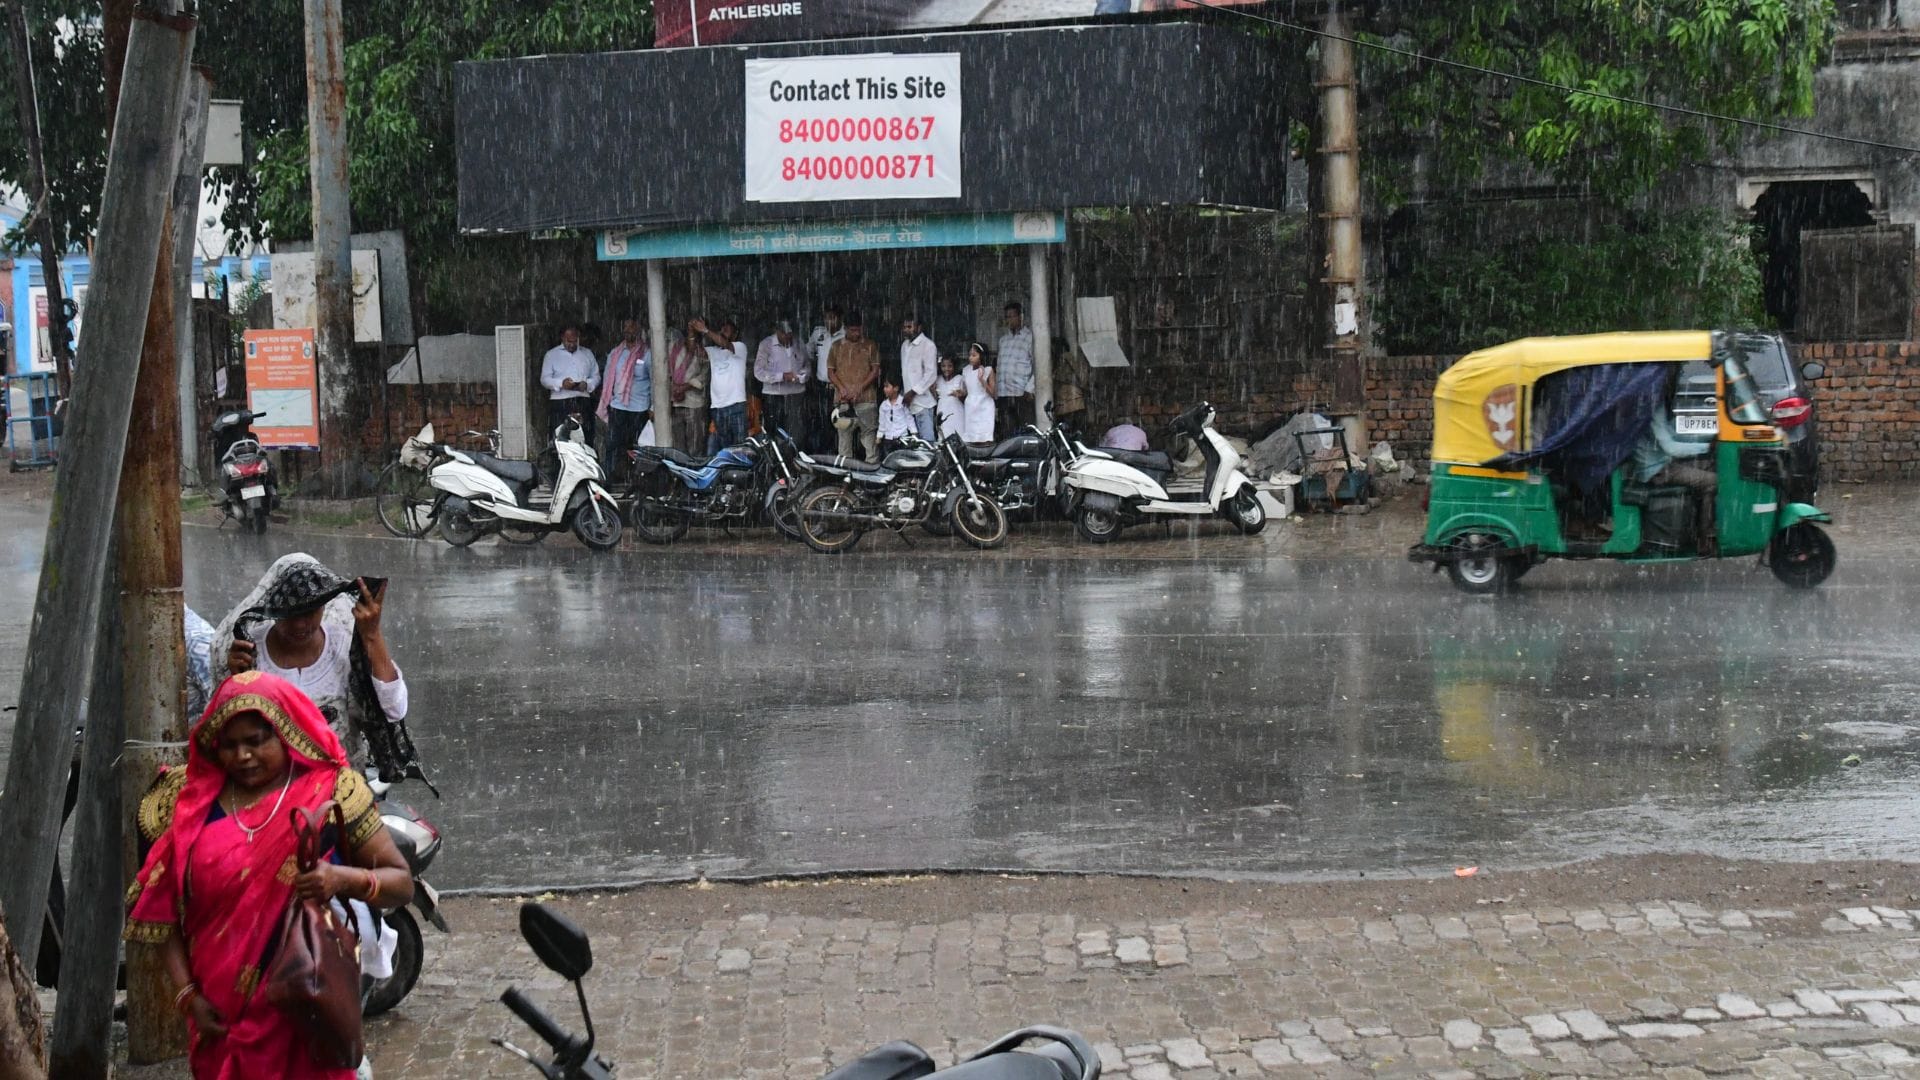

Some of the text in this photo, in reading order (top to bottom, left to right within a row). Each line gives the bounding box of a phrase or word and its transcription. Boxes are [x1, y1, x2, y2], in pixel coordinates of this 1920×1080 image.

[708, 2, 802, 20] ATHLEISURE
[769, 75, 946, 102] Contact This Site
[778, 115, 935, 143] 8400000867
[781, 154, 934, 181] 8400000871
[896, 228, 922, 242] रोड
